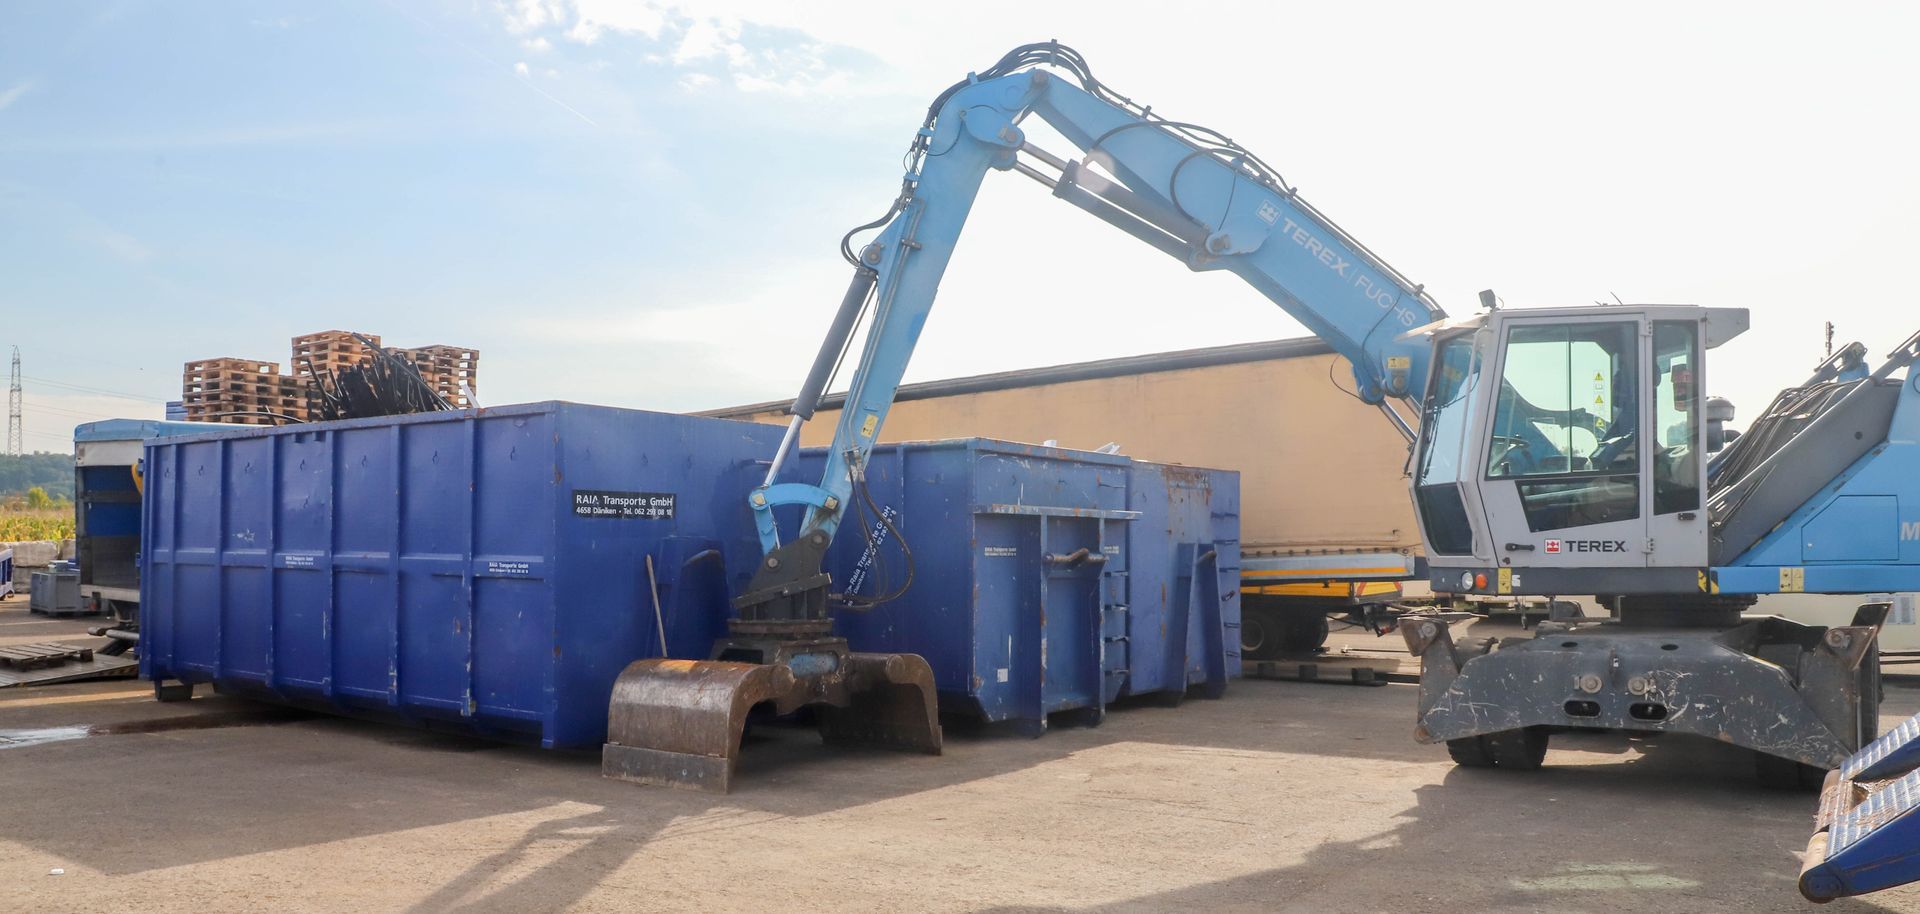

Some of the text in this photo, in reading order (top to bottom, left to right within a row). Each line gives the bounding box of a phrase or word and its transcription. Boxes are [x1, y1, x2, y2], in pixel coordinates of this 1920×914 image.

[1281, 217, 1350, 277] TEREX
[603, 495, 646, 507] Transporte
[650, 497, 673, 506] GmbH
[1565, 541, 1626, 552] TEREX
